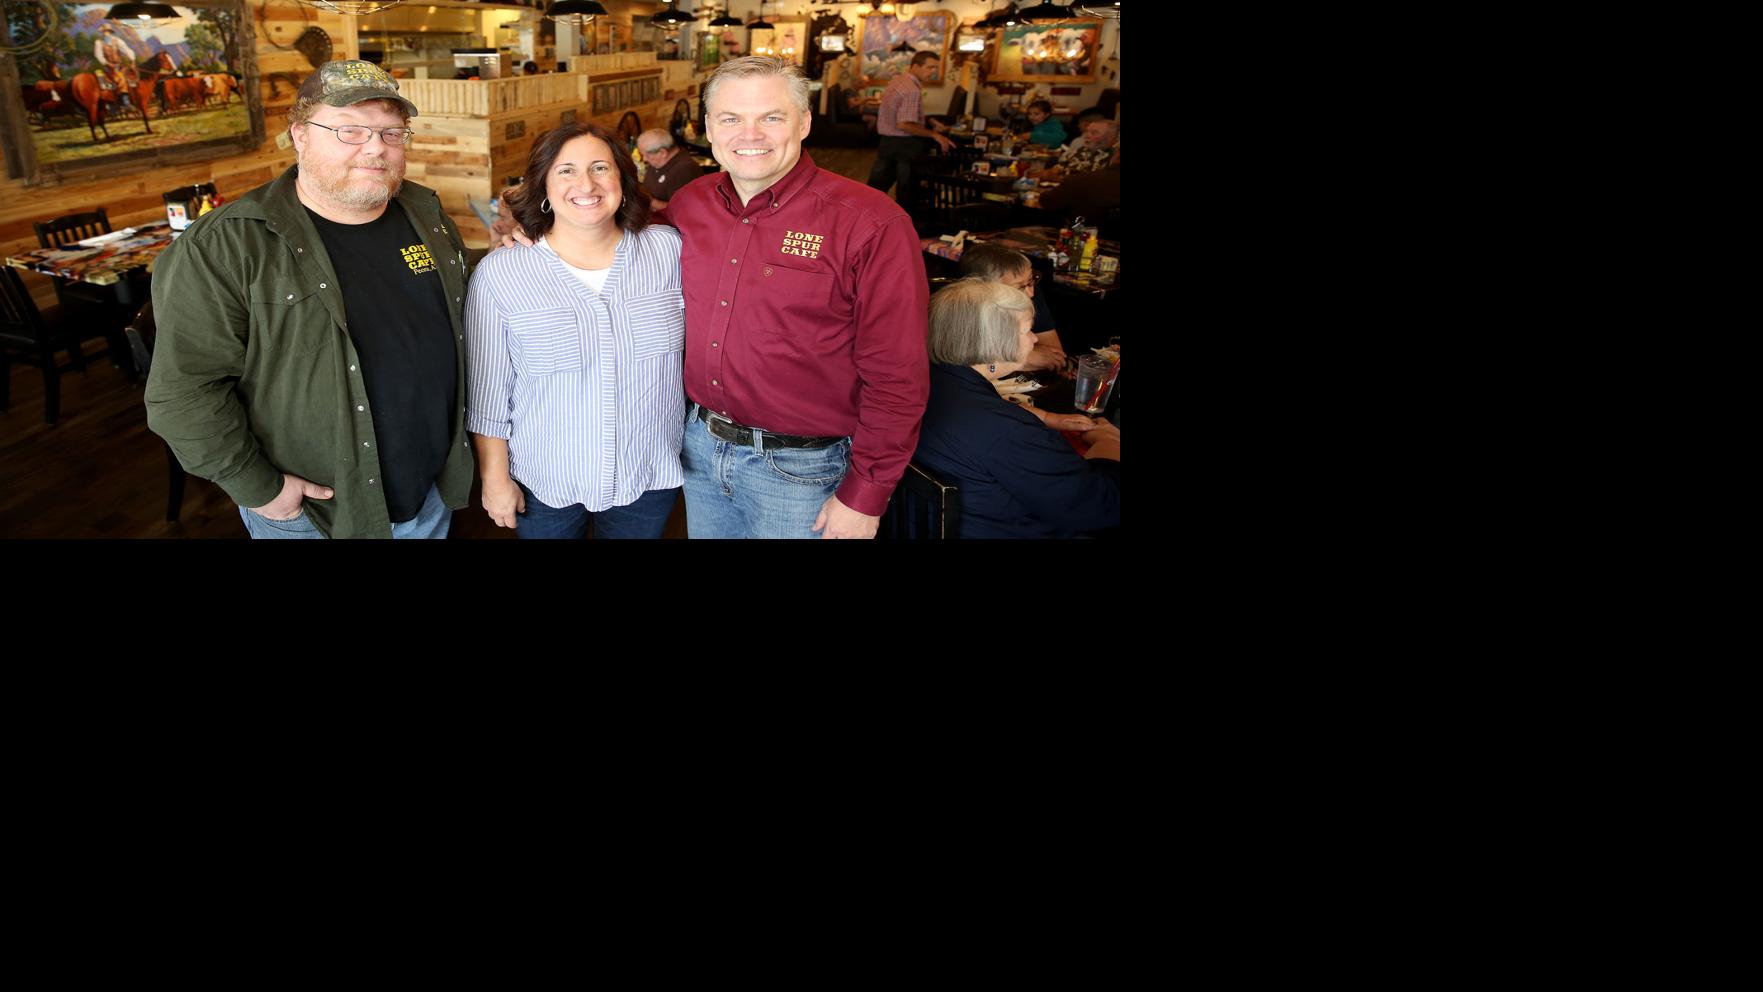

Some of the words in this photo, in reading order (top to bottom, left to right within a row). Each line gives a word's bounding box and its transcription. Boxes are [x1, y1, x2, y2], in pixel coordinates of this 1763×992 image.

[785, 230, 824, 243] LONE
[783, 238, 820, 251] SPUR
[781, 246, 818, 259] CAFE
